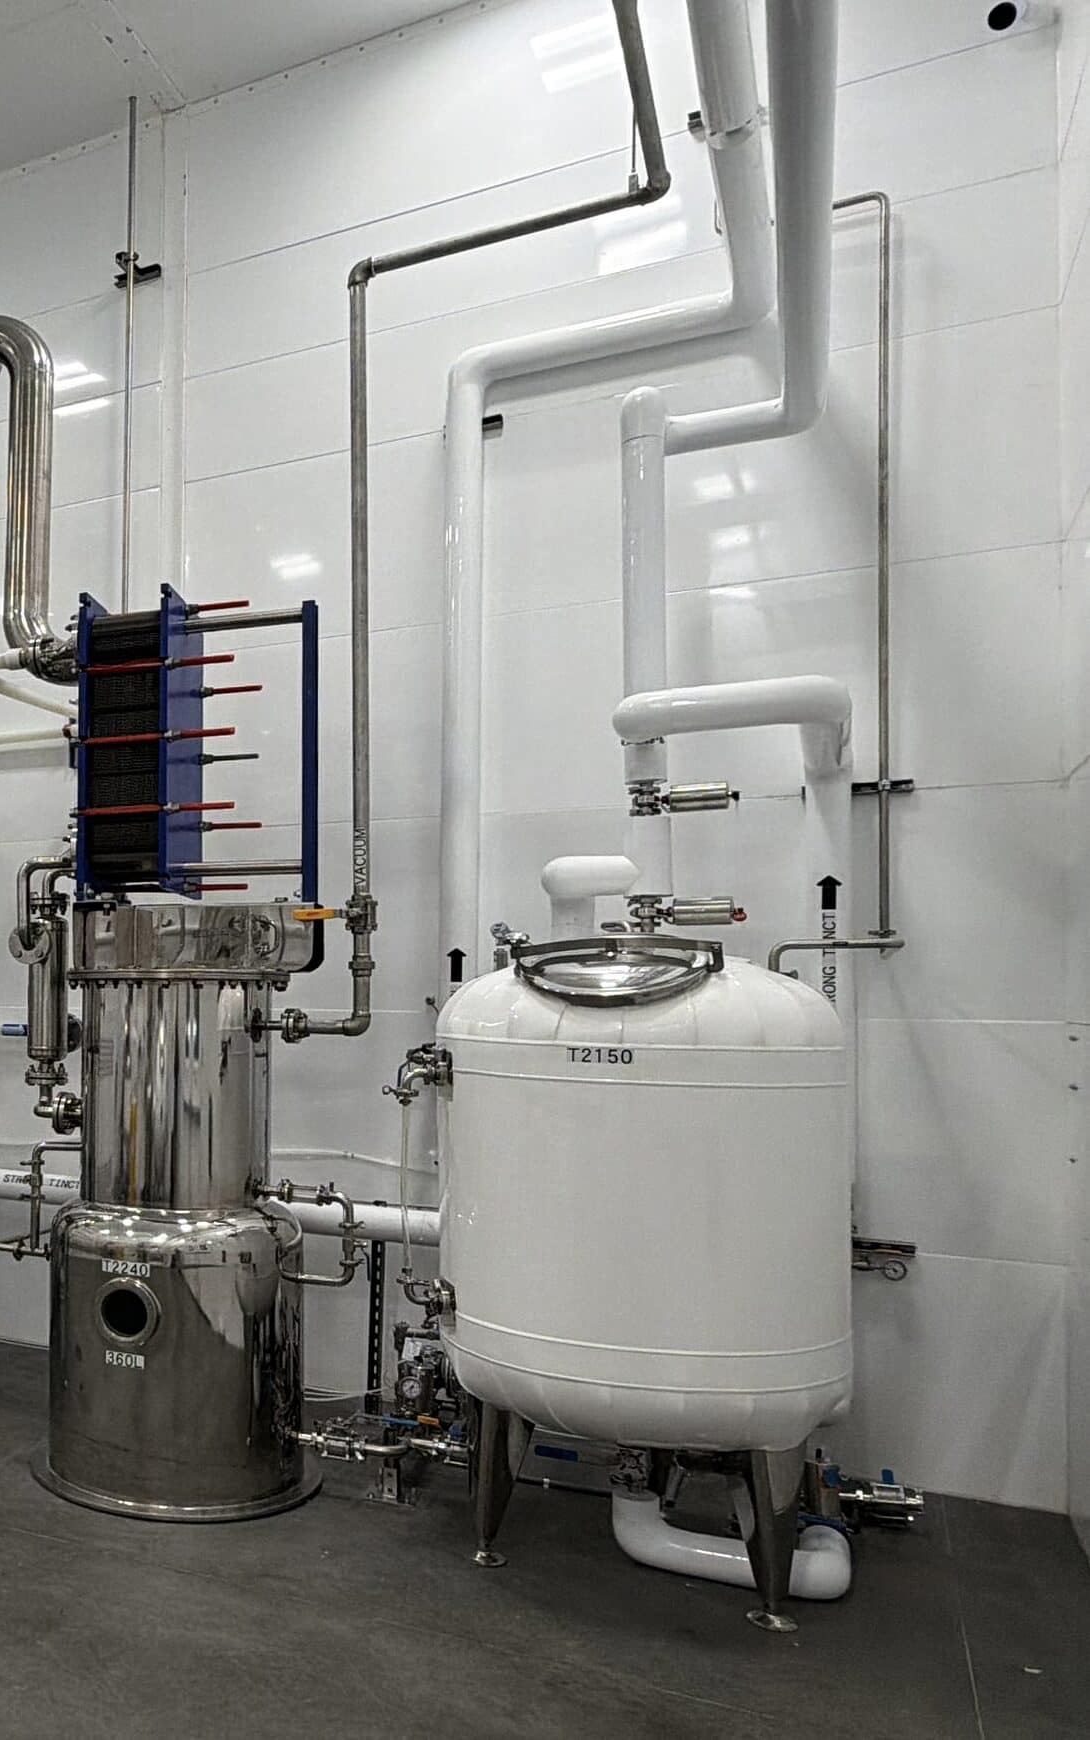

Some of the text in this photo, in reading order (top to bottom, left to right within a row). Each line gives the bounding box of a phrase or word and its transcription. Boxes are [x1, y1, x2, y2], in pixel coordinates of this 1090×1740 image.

[353, 826, 367, 886] VACUUM
[821, 912, 837, 958] TNCT
[566, 1047, 633, 1065] T2150
[103, 1260, 148, 1276] T2240
[107, 1351, 143, 1368] 360L
